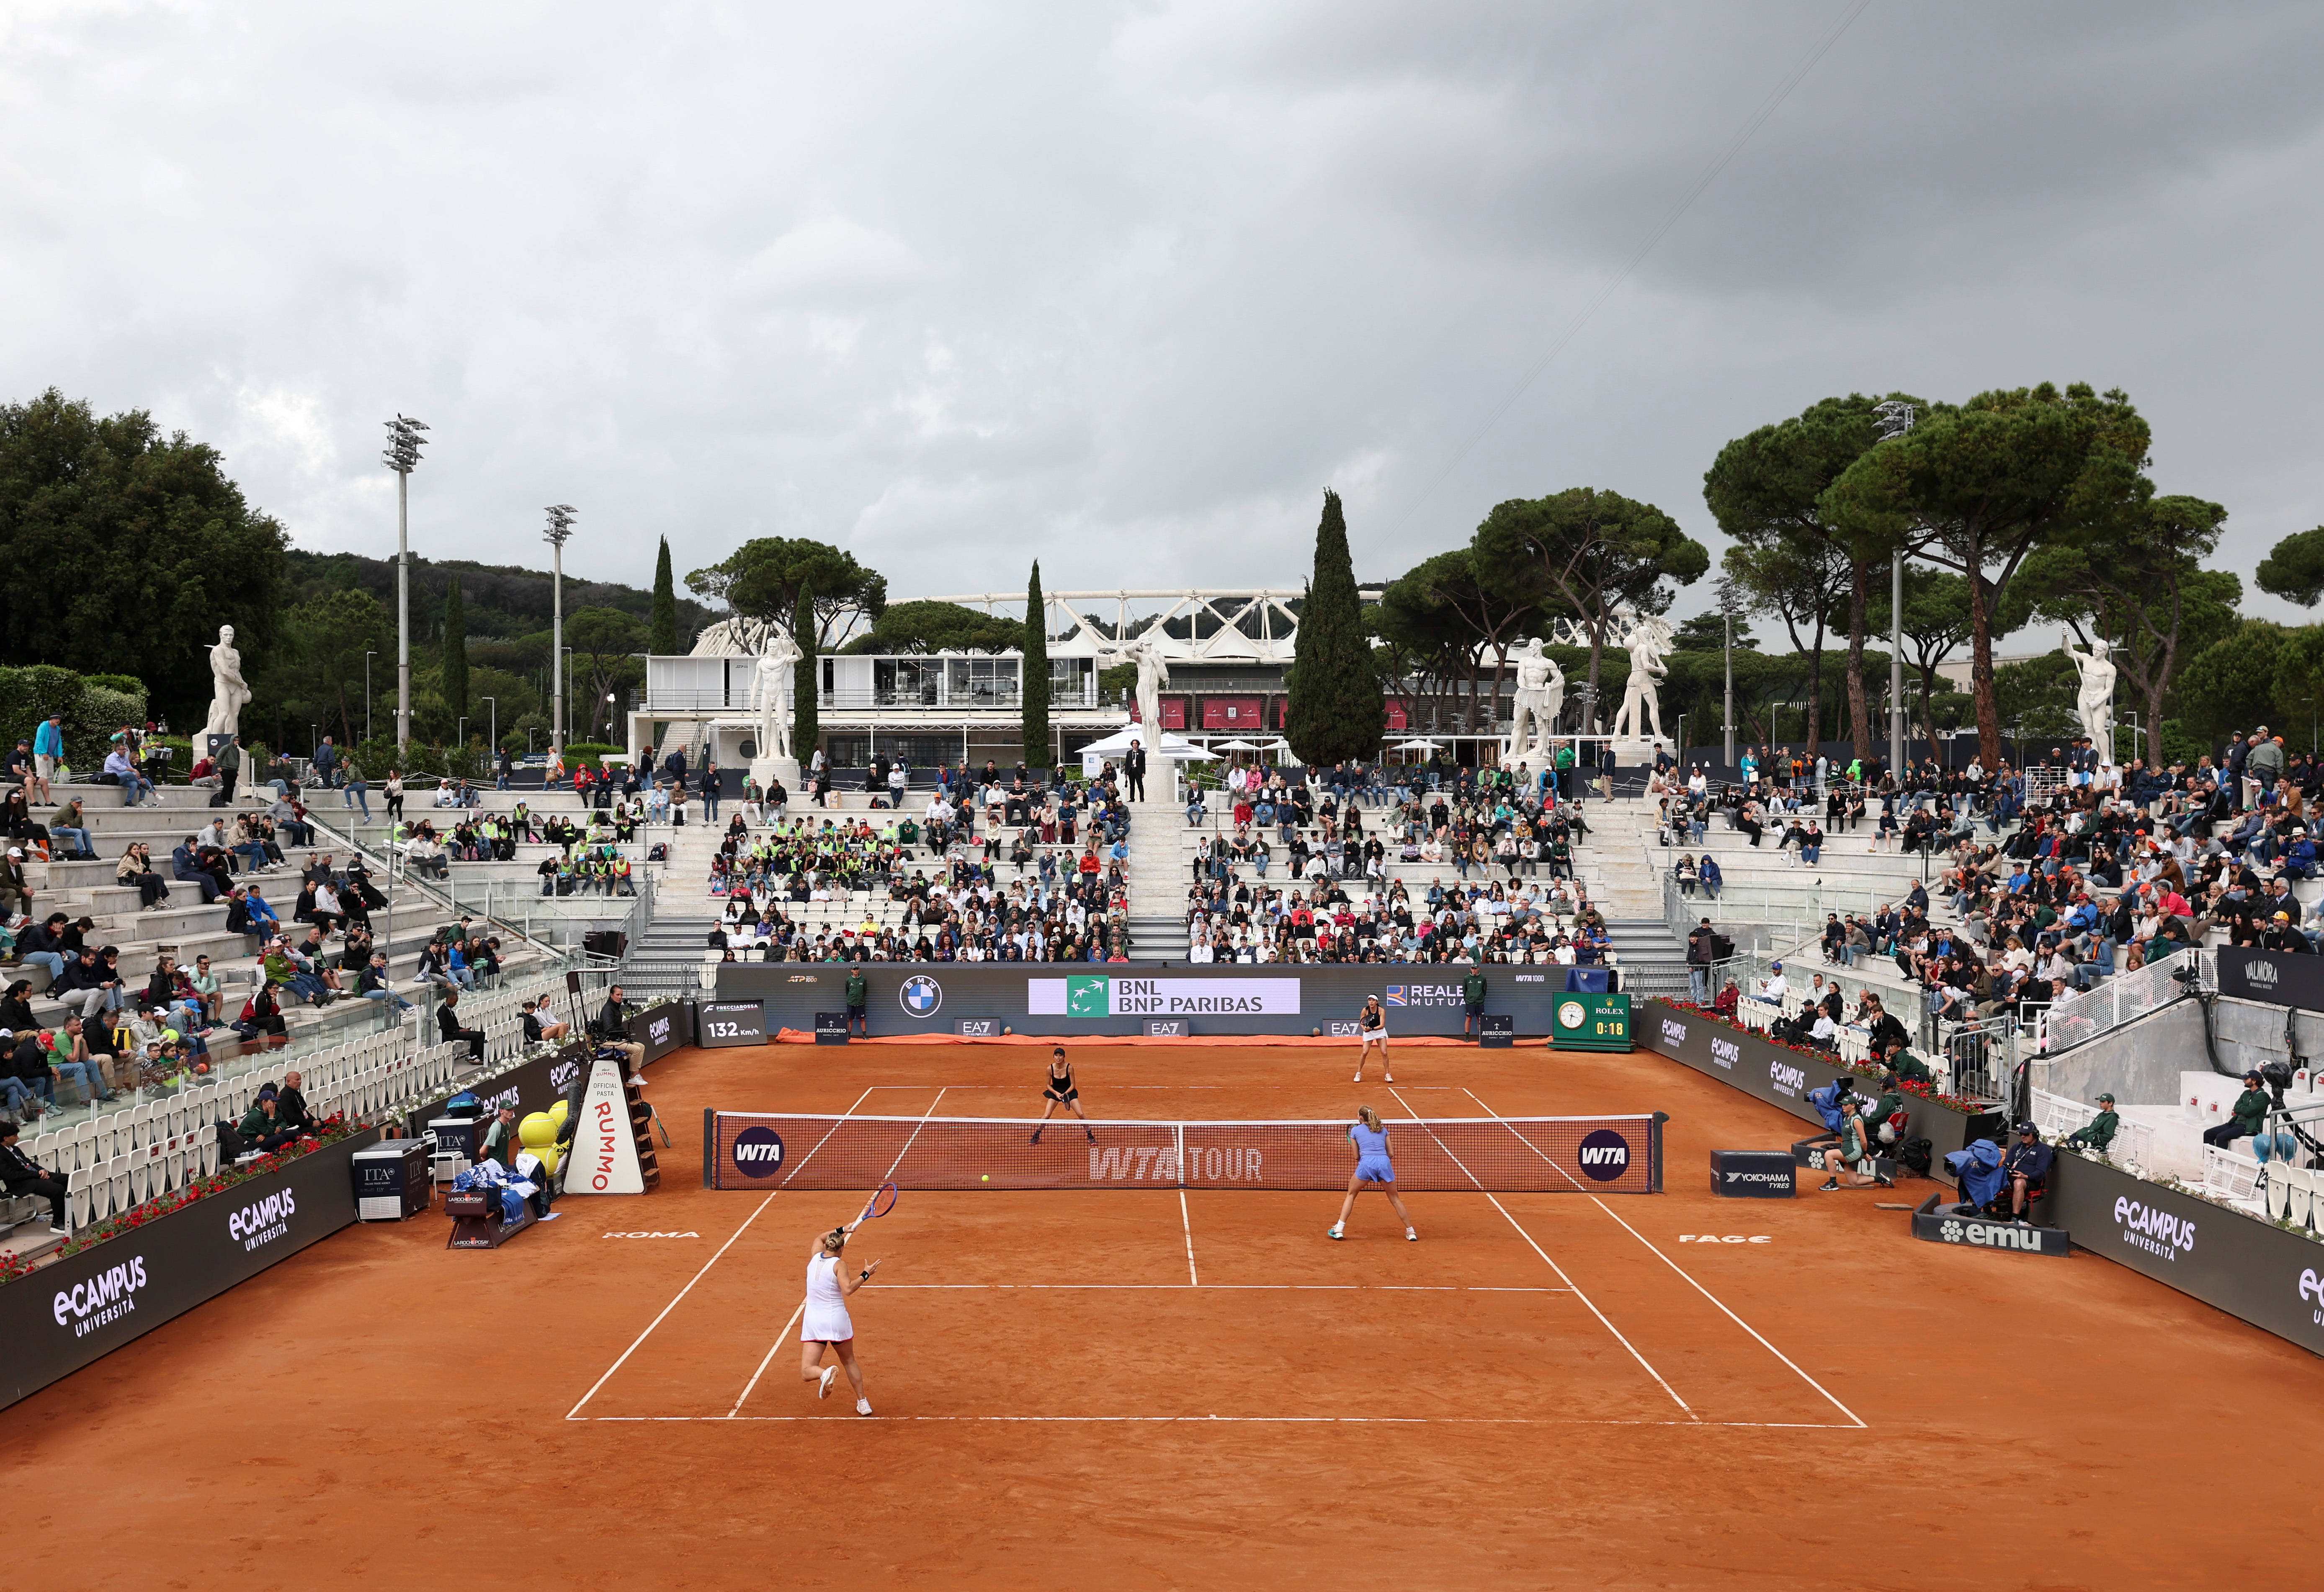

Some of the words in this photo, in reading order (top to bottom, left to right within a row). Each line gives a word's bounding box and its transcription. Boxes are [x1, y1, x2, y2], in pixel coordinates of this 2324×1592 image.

[2245, 960, 2278, 984] VALMORA
[905, 977, 936, 990] BMW
[1119, 980, 1162, 995] BNL
[1411, 985, 1464, 997] REALE
[1119, 997, 1163, 1012] BNP
[1170, 997, 1262, 1012] PARIBAS
[708, 1022, 738, 1037] 132
[964, 1022, 991, 1033] EA7
[1152, 1023, 1179, 1034] EA7
[1332, 1023, 1359, 1034] EA7
[1596, 1022, 1623, 1035] 0:18
[654, 1033, 667, 1046] UNIVERSITÀ
[1664, 1036, 1679, 1047] UNIVERSITÀ
[1713, 1056, 1731, 1070] UNIVERSITÀ
[1773, 1081, 1795, 1098] UNIVERSITÀ
[438, 1135, 461, 1147] ITA
[592, 1101, 615, 1191] RUMMO
[737, 1144, 779, 1161] WTA
[1582, 1147, 1625, 1164] WTA
[1090, 1148, 1175, 1179] WTA
[1188, 1147, 1262, 1180] TOUR
[364, 1168, 390, 1181] ITA
[1741, 1173, 1790, 1182] YOKOHAMA
[229, 1187, 295, 1242] eCAMPUS
[2114, 1195, 2196, 1252] eCAMPUS
[245, 1218, 288, 1252] UNIVERSITÀ
[1679, 1235, 1772, 1243] FAGE
[1966, 1224, 2041, 1251] emu
[2123, 1229, 2175, 1262] UNIVERSITÀ
[54, 1256, 147, 1326] eCAMPUS
[75, 1293, 135, 1338] UNIVERSITÀ
